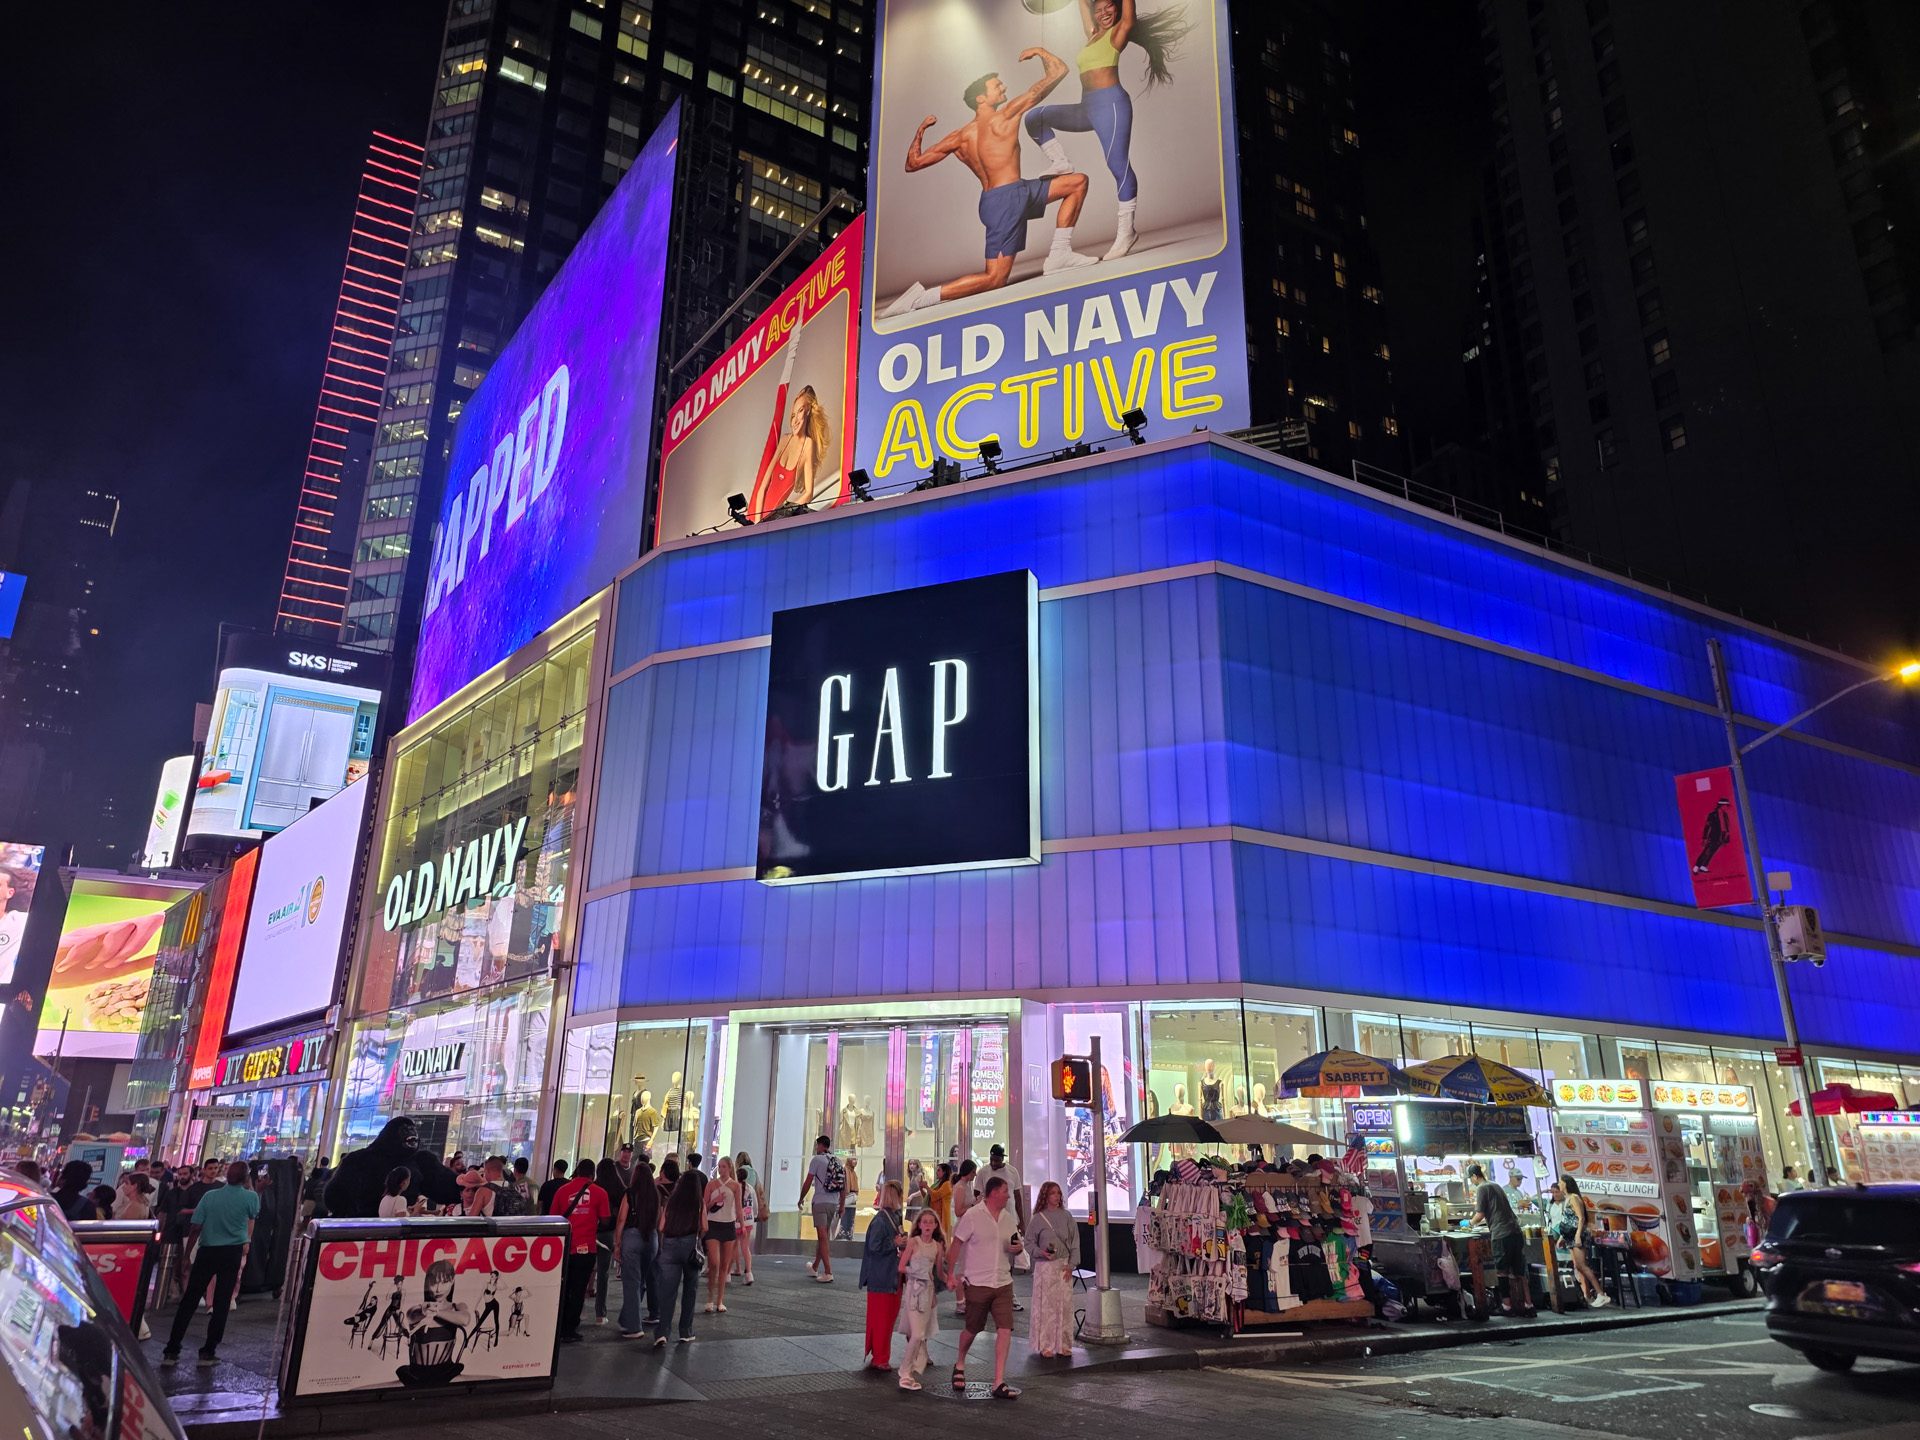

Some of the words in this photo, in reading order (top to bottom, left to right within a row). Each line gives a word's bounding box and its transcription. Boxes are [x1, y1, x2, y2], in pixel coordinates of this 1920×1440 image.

[878, 322, 1005, 394] OLD
[1024, 270, 1219, 363] NAVY
[670, 386, 708, 441] OLD
[707, 327, 767, 408] NAVY
[765, 245, 847, 352] ACTIVE
[873, 334, 1223, 478] ACTIVE
[288, 651, 327, 670] SKS
[816, 658, 968, 792] GAP
[383, 859, 434, 931] OLD
[435, 816, 528, 912] NAVY
[268, 908, 281, 925] EVA
[281, 902, 295, 919] AIR
[243, 1046, 283, 1083] GIFTS
[282, 1042, 293, 1075] I
[403, 1050, 426, 1077] OLD
[425, 1043, 461, 1074] NAVY
[1326, 1071, 1385, 1083] SABRETT
[1411, 1077, 1438, 1093] BRETT
[982, 1083, 1004, 1092] BODY
[987, 1094, 1000, 1103] FIT
[973, 1105, 997, 1115] MENS
[1355, 1108, 1392, 1125] OPEN
[975, 1117, 995, 1127] KIDS
[973, 1129, 996, 1139] BABY
[1579, 1181, 1612, 1192] AKFAST
[1613, 1184, 1621, 1193] &
[1623, 1184, 1654, 1195] LUNCH
[319, 1235, 564, 1282] CHICAGO
